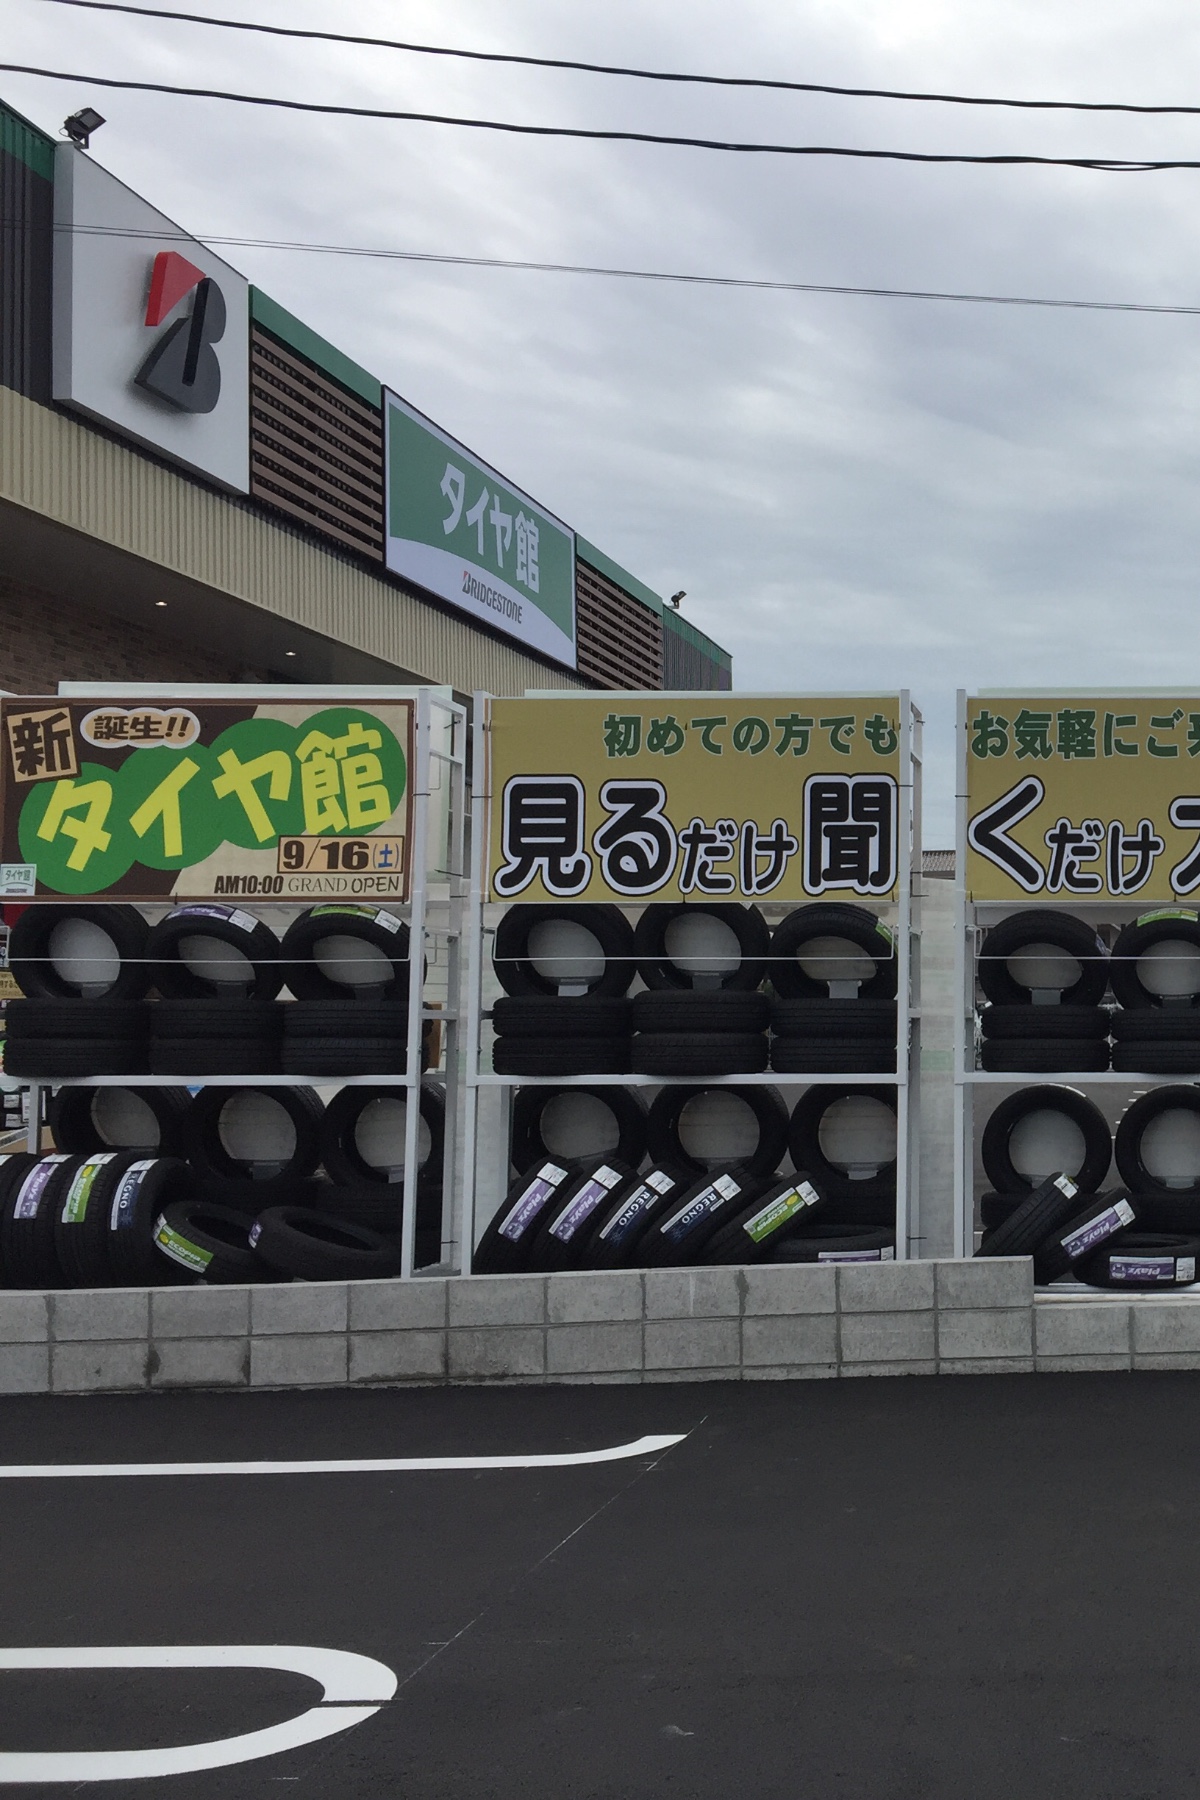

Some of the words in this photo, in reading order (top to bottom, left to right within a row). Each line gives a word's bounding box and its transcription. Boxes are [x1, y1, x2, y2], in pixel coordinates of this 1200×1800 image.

[440, 462, 540, 594] タイヤ館
[462, 571, 522, 624] BRIDGESTONE
[11, 711, 72, 777] 新
[93, 714, 188, 741] 誕生!!
[603, 713, 898, 758] 初めての方でも
[37, 722, 393, 872] タイヤ館
[282, 839, 400, 871] 9/16(土)
[493, 773, 899, 898] 見るだけ聞
[213, 875, 284, 895] AM10:00
[287, 878, 348, 893] GRAND
[350, 875, 400, 894] OPEN
[618, 1191, 651, 1227] REGNO
[681, 1192, 717, 1225] REGNO
